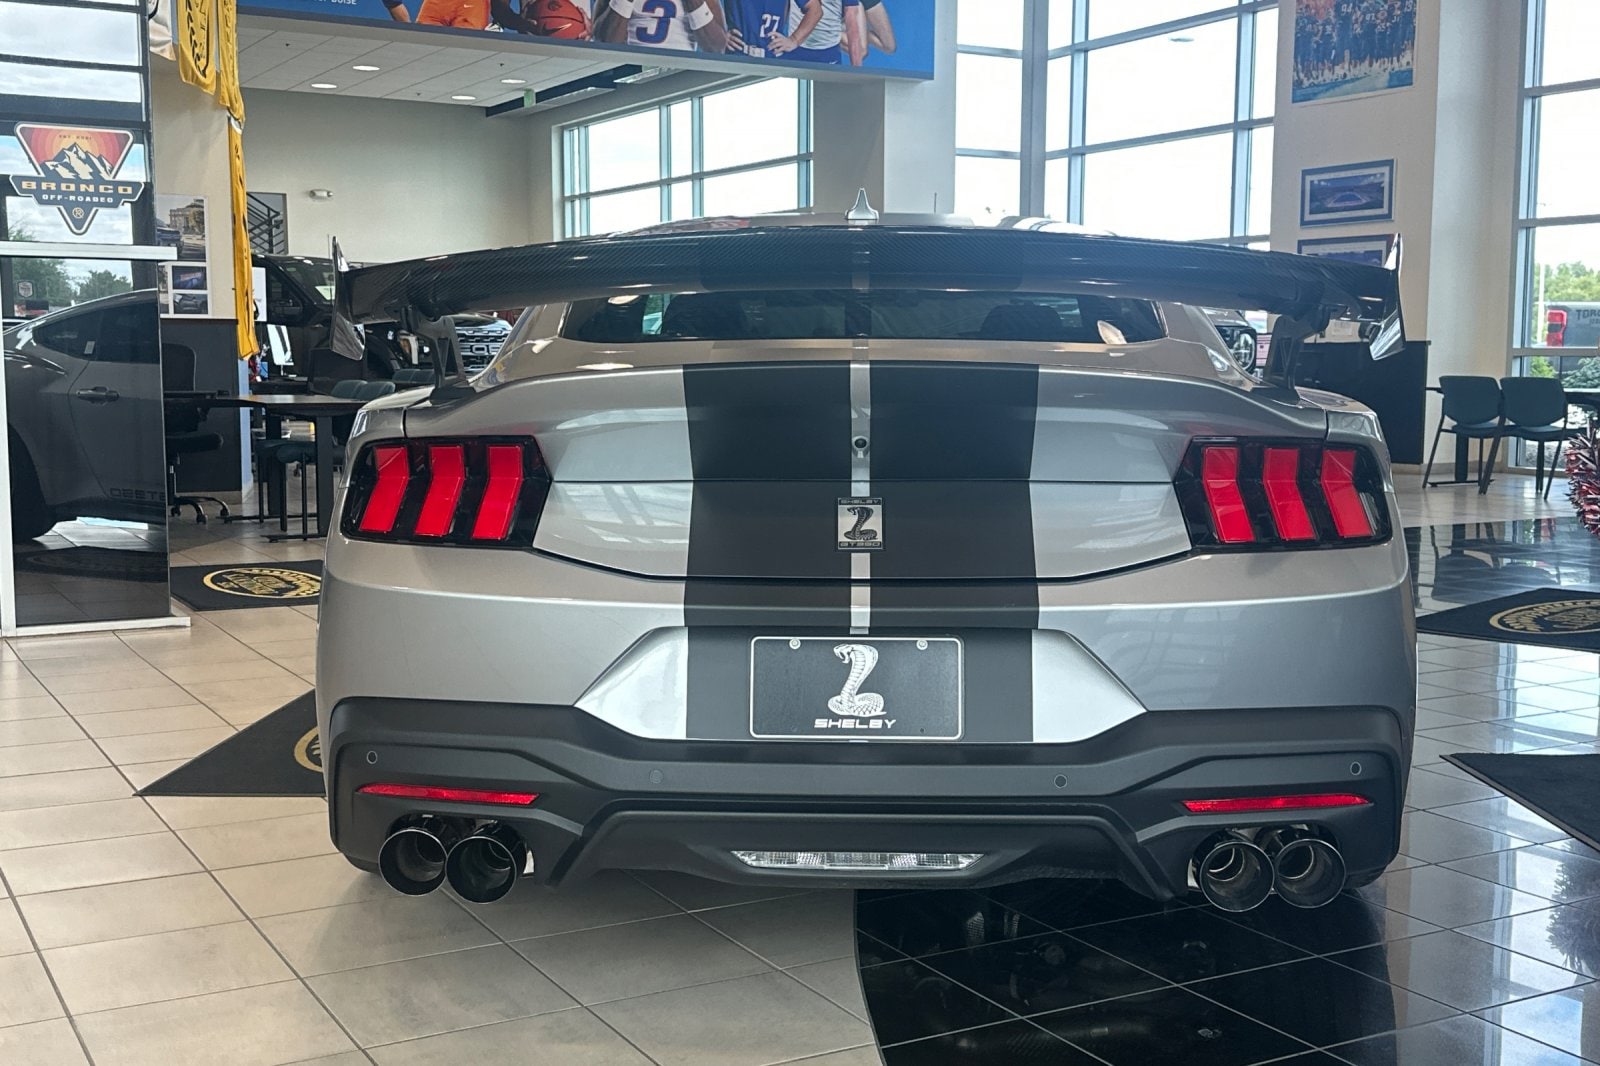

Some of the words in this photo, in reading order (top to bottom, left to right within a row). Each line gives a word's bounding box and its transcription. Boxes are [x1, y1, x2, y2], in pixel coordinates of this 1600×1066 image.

[636, 0, 677, 44] 3
[760, 13, 781, 38] 27
[21, 181, 133, 194] BRONCO
[814, 718, 897, 729] SHELBY
